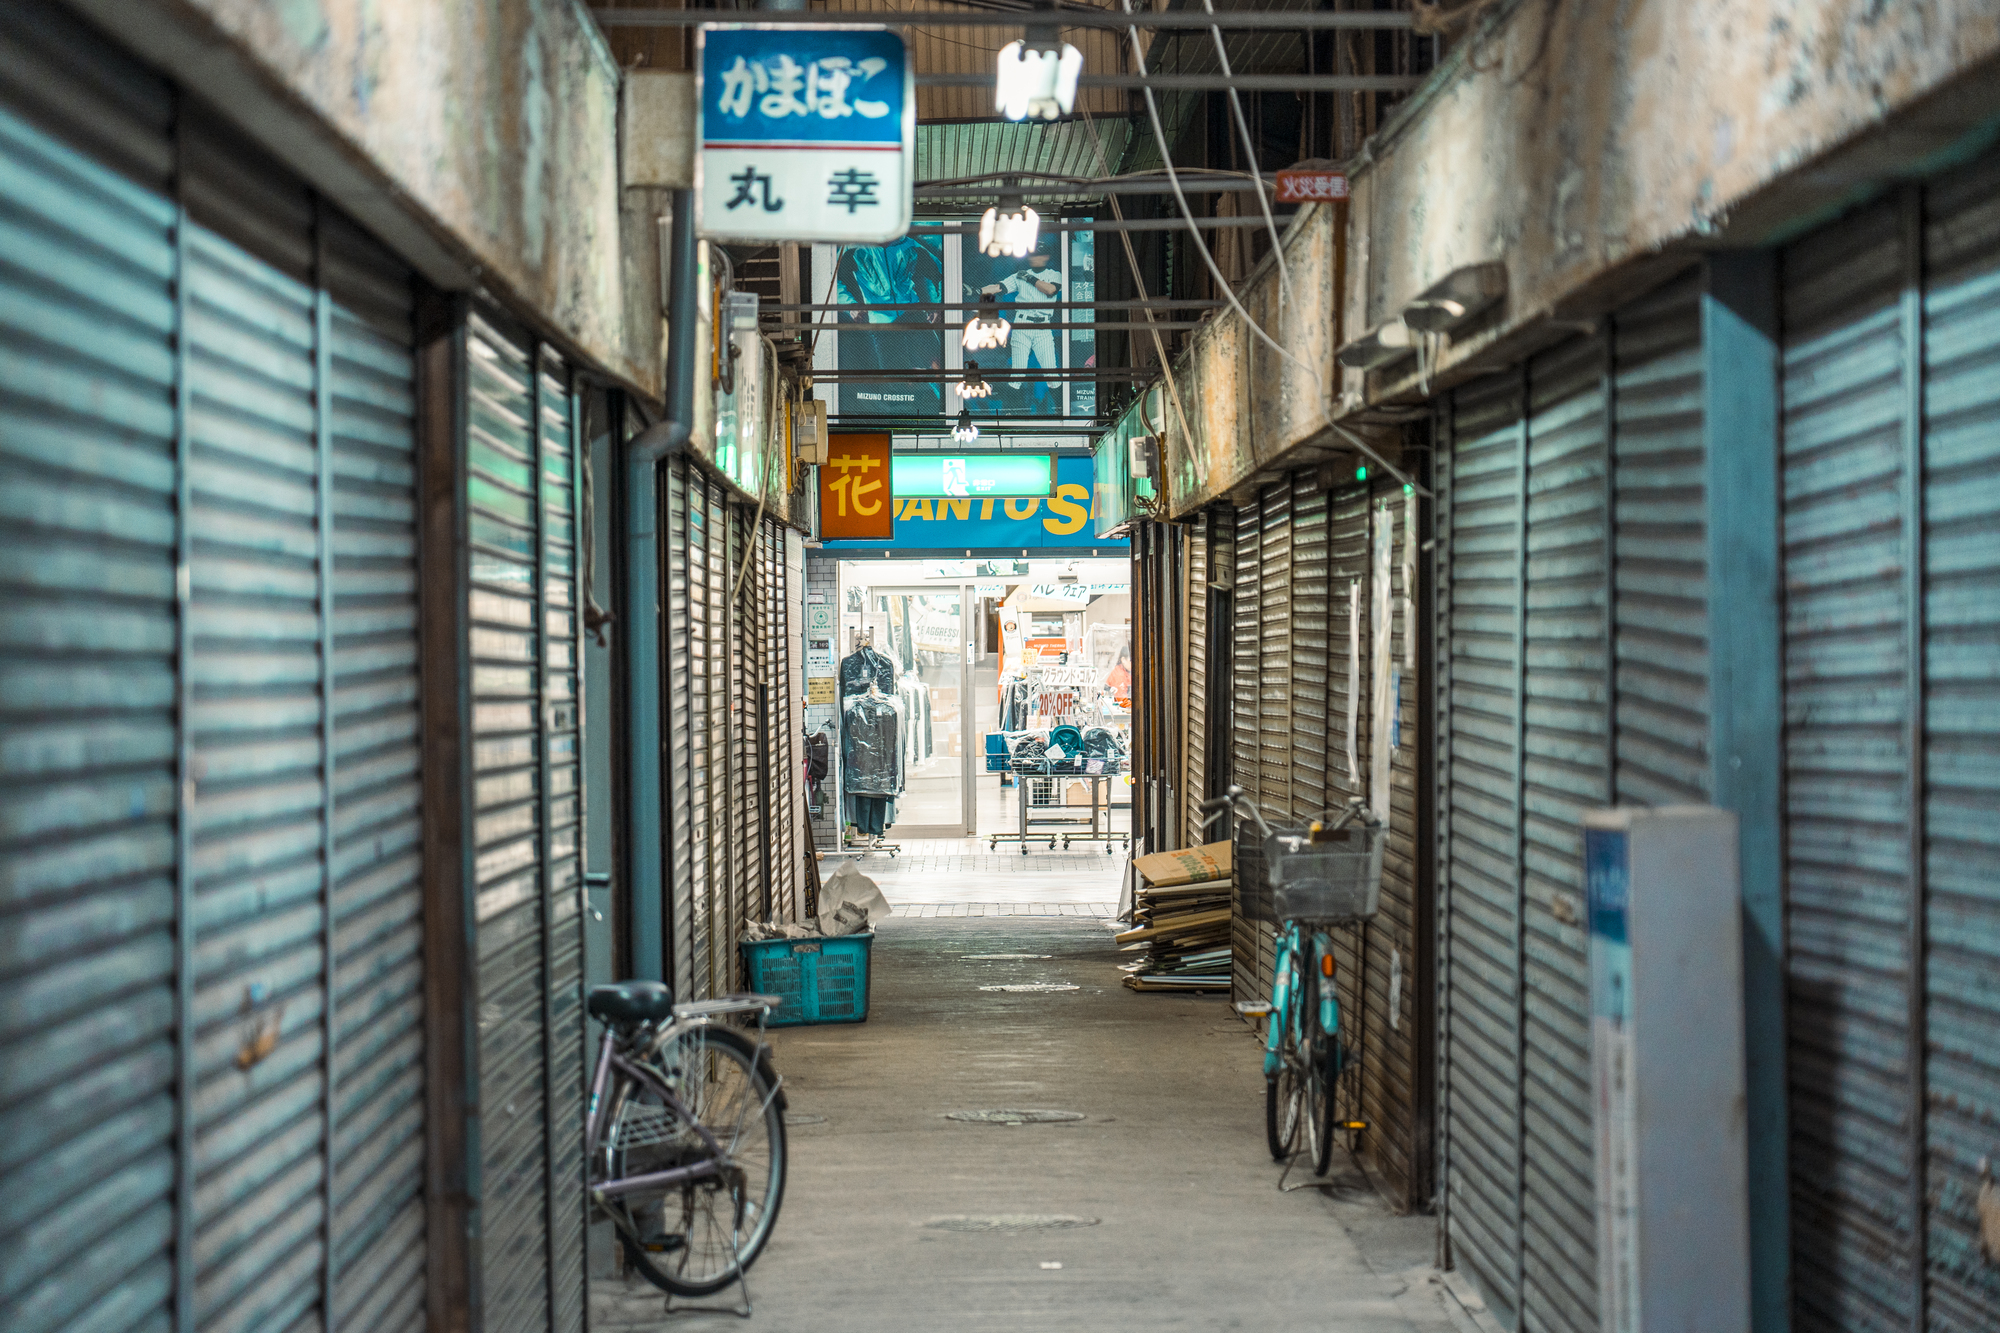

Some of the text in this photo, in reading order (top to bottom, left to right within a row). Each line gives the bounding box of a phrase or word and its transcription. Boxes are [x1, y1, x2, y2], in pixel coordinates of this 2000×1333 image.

[719, 54, 890, 119] かまぼこ
[1284, 176, 1348, 198] 火災受信
[857, 392, 915, 402] MIZUNO CROSSTIC
[829, 454, 882, 517] 花
[1042, 484, 1095, 535] S
[1043, 667, 1097, 685] グラウンド・ゴルフ
[1039, 692, 1073, 717] 20%OFF
